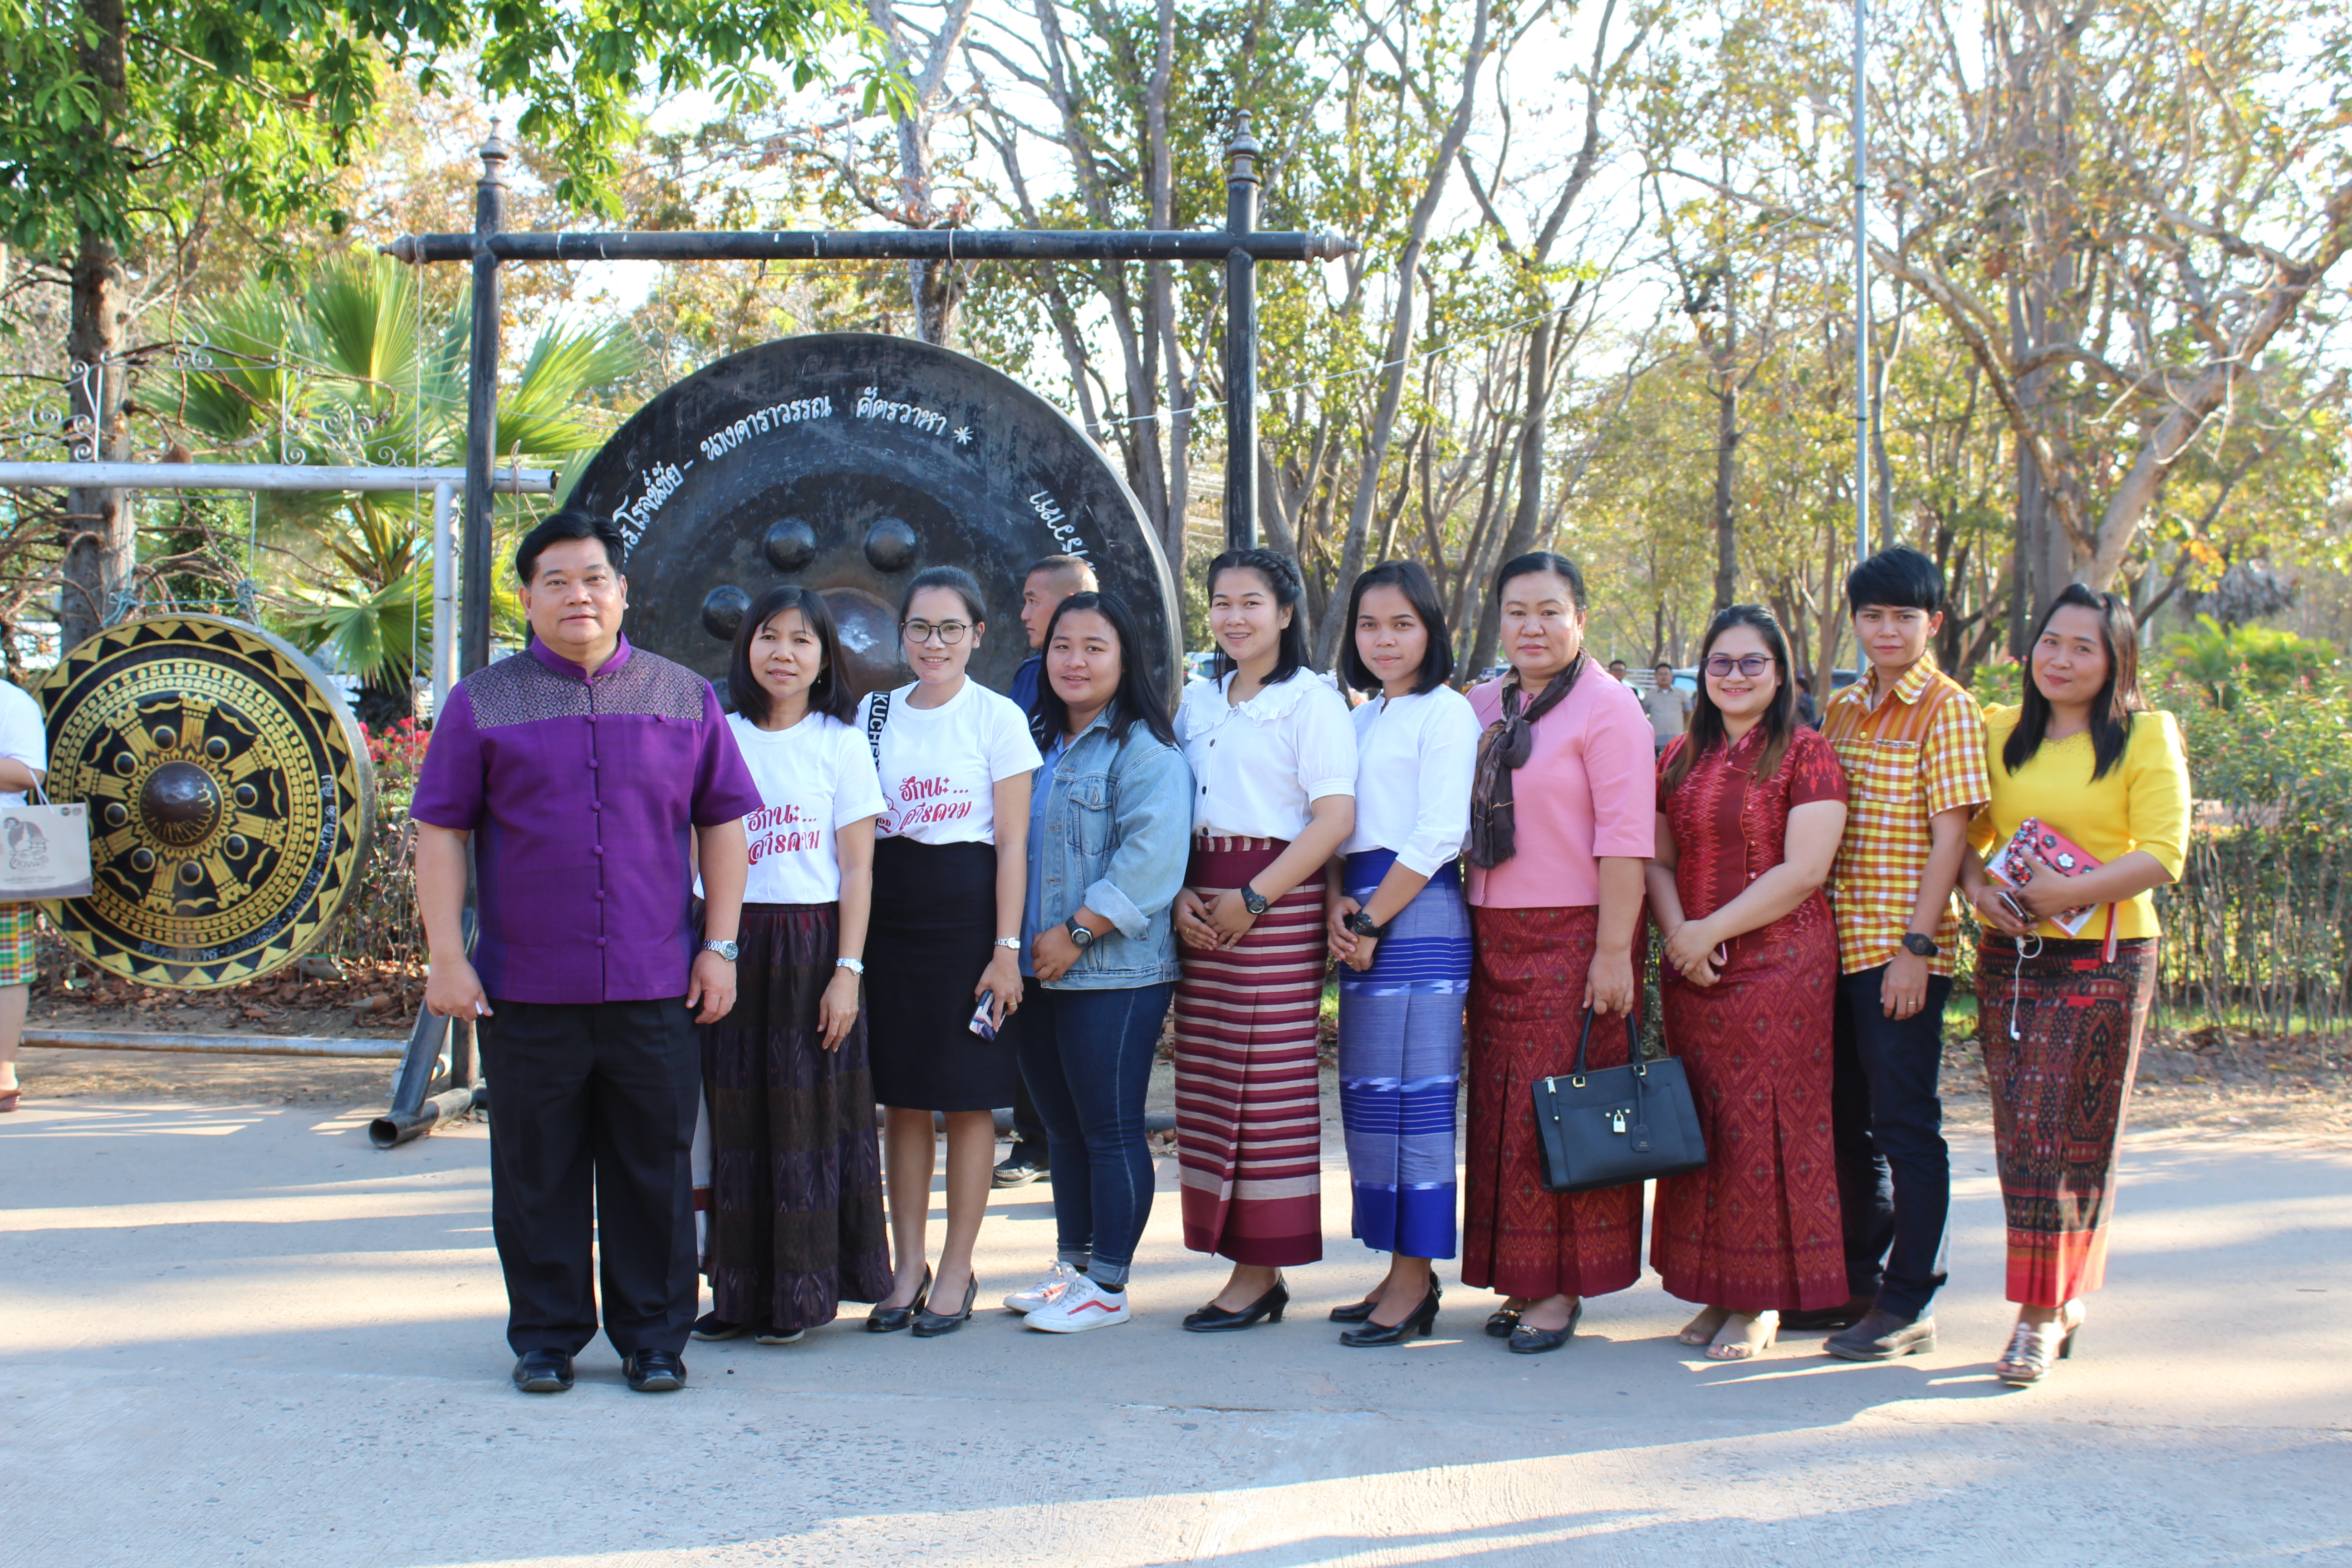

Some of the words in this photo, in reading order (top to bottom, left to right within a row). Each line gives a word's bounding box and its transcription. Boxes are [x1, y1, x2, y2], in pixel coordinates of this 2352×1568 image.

[612, 461, 684, 557] ร.โรจน์ชัย
[700, 395, 832, 461] นางดาราวรรณ
[899, 801, 972, 831] สารคาม
